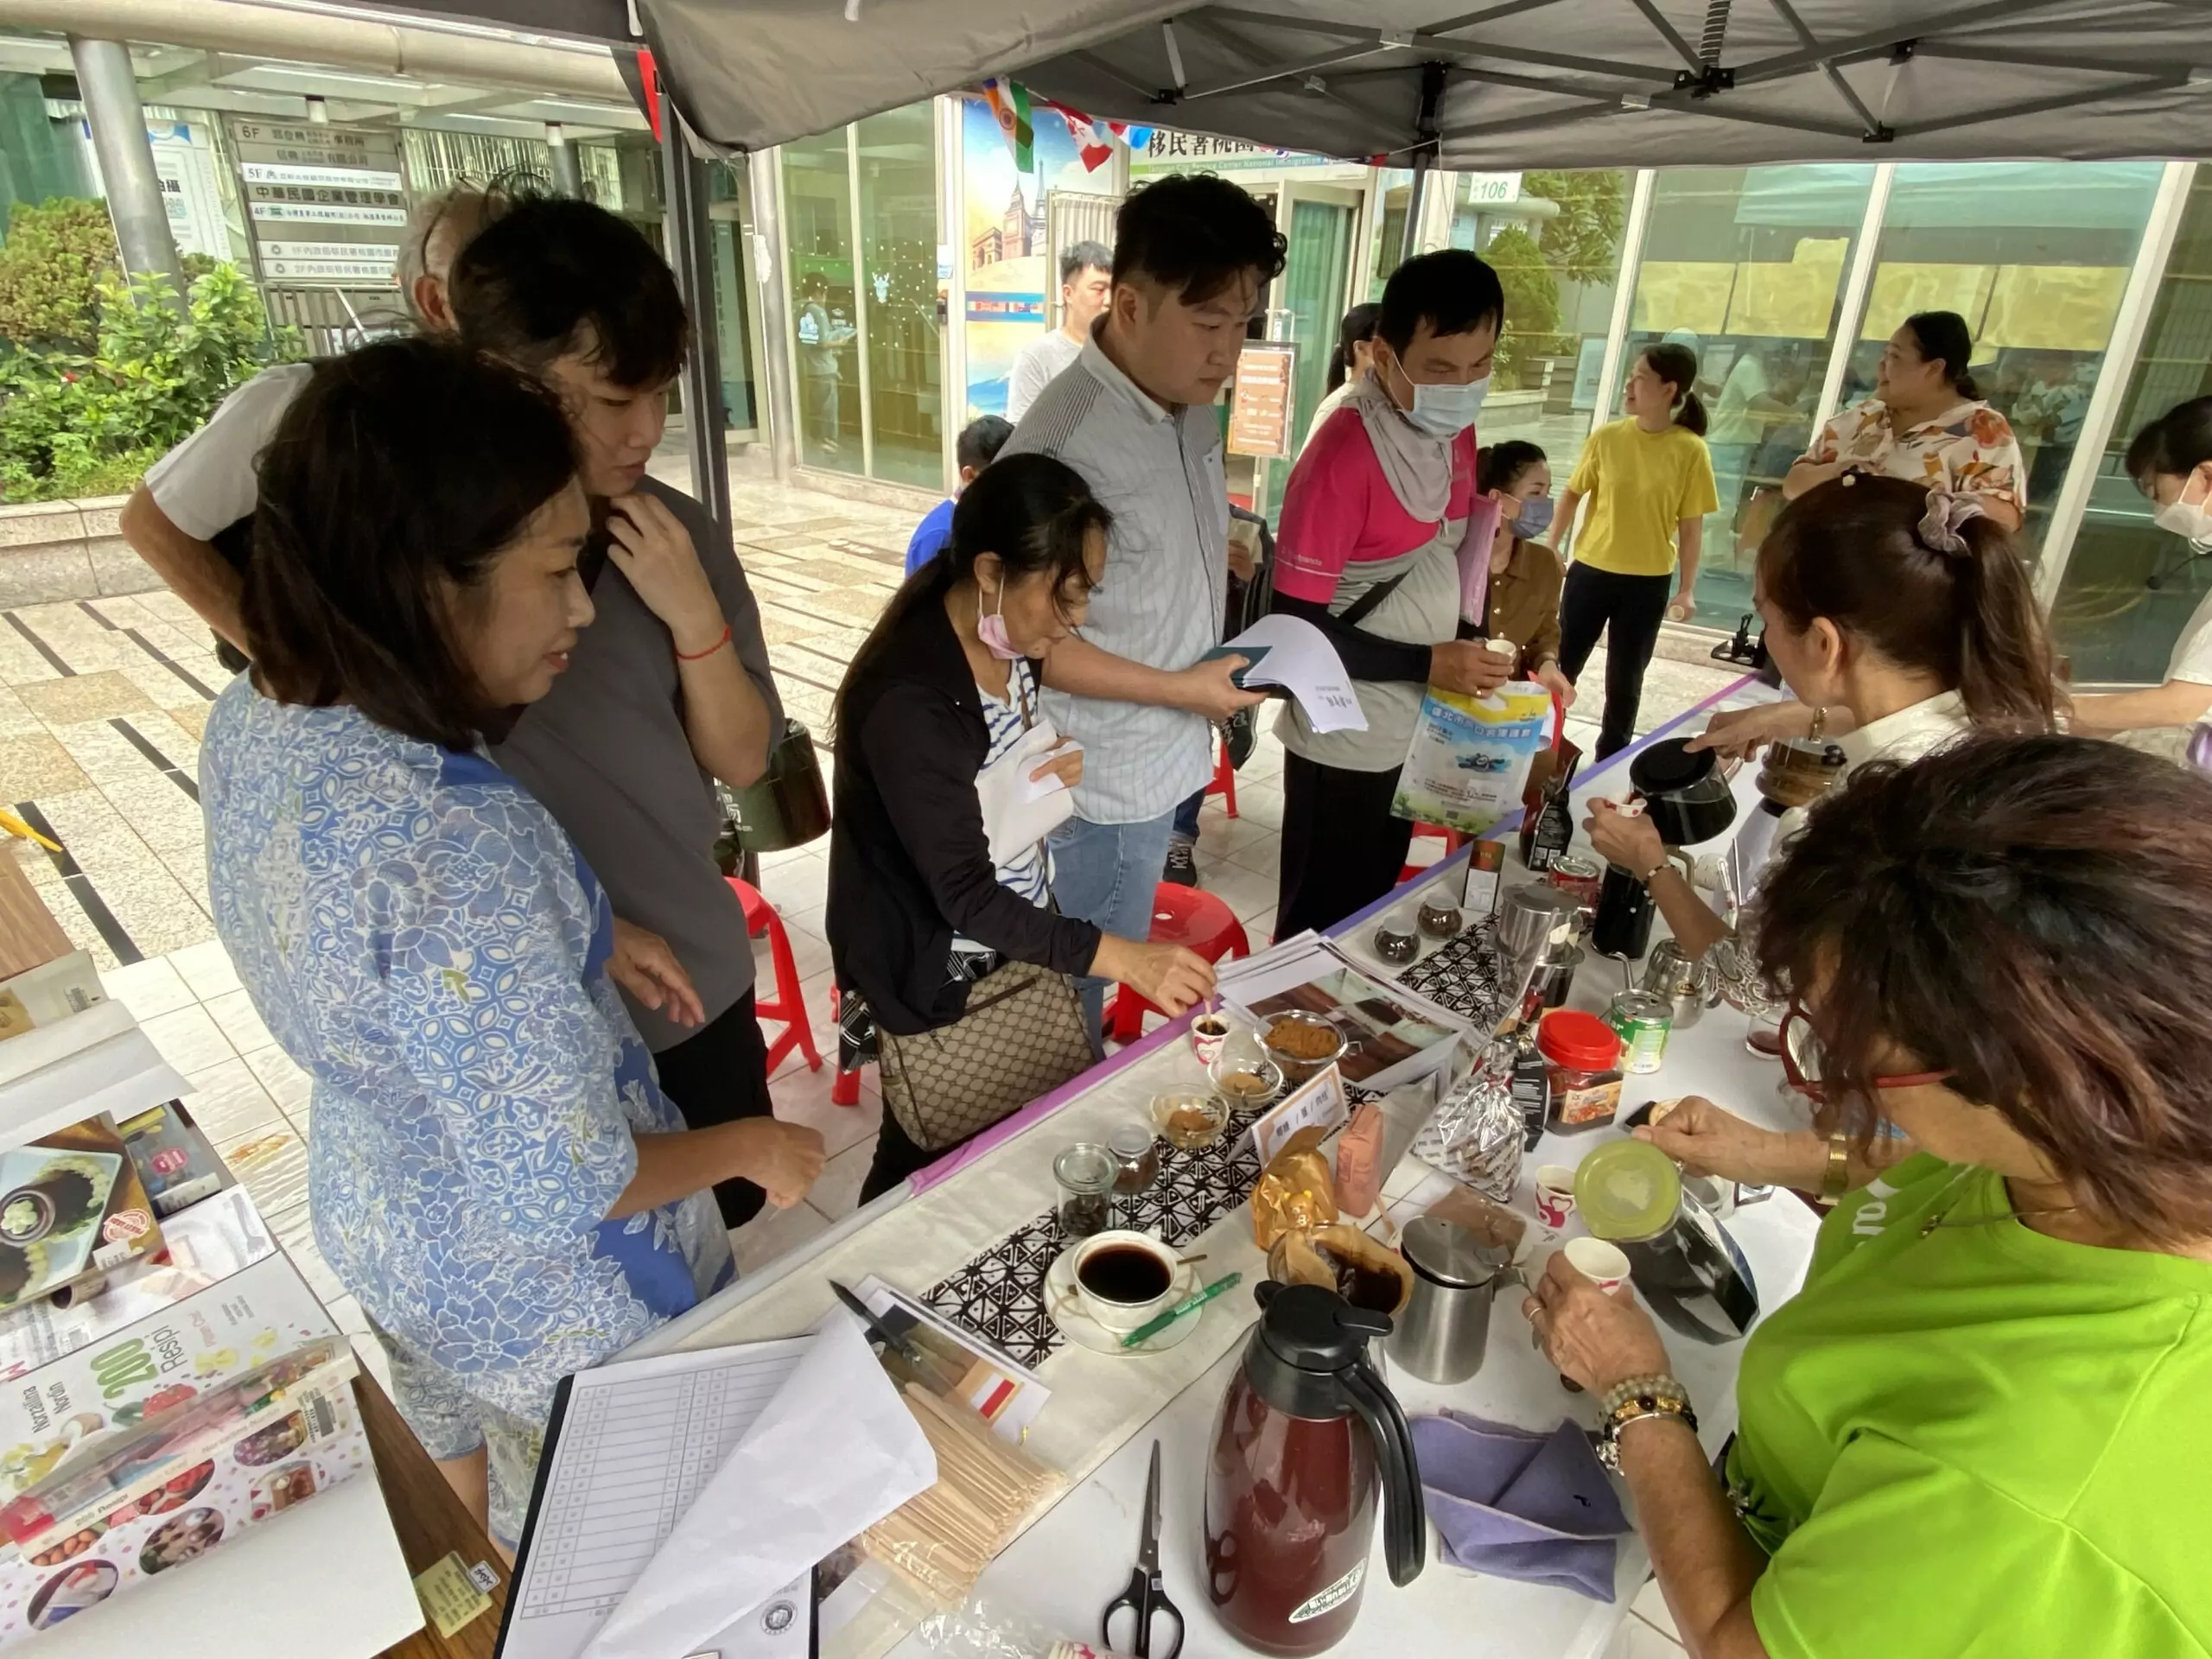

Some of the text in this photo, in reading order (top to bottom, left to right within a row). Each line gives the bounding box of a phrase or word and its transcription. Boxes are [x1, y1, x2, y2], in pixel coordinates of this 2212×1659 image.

[242, 125, 260, 139] 6F
[248, 168, 263, 179] 5F
[1192, 161, 1217, 173] Service
[1218, 159, 1242, 169] Center
[1243, 156, 1274, 168] National
[256, 186, 399, 206] 中華民國企業管理學會
[1481, 181, 1509, 200] 106
[144, 1325, 188, 1374] Resipi
[91, 1338, 159, 1400] 200
[47, 1381, 73, 1415] Nordin
